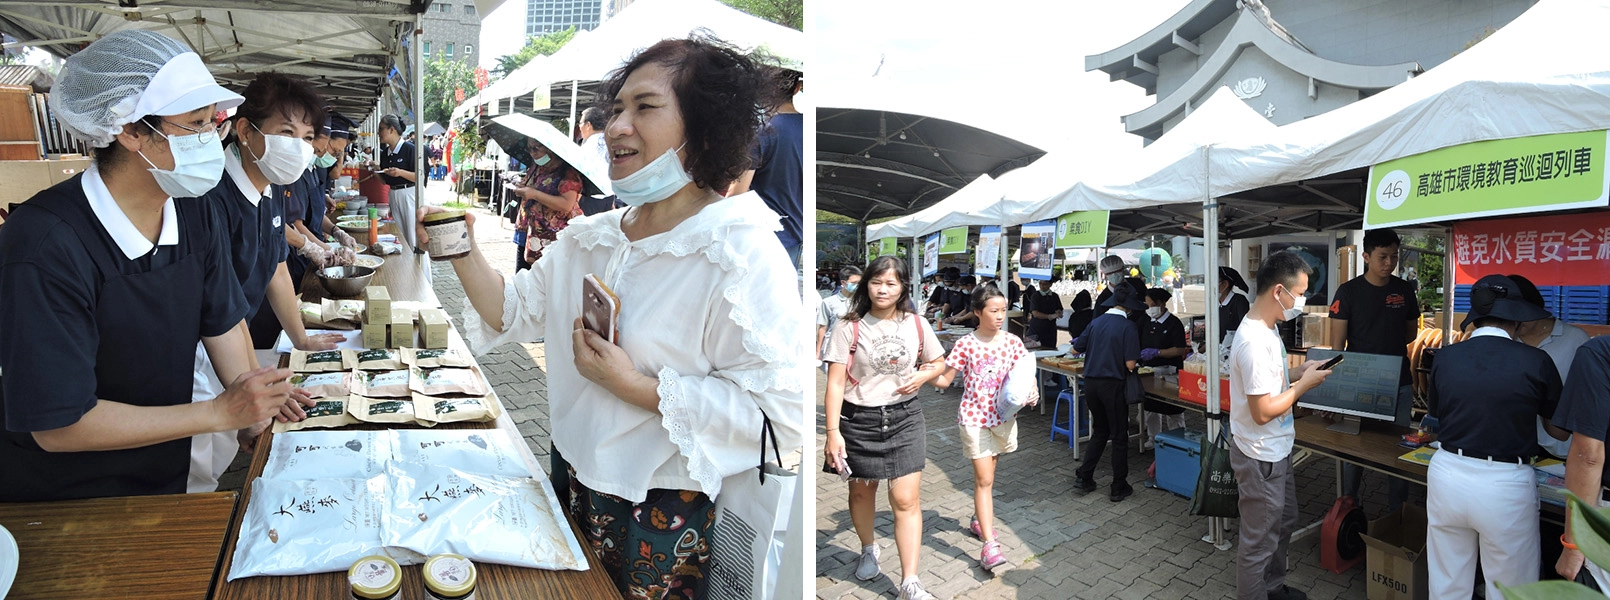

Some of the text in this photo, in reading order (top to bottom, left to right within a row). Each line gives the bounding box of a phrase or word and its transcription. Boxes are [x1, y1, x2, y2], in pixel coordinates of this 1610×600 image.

[1264, 102, 1276, 118] 堂
[1382, 146, 1592, 199] 46 高雄市環境教育巡迴列車
[1329, 299, 1340, 314] 4
[1372, 571, 1407, 594] LFX500
